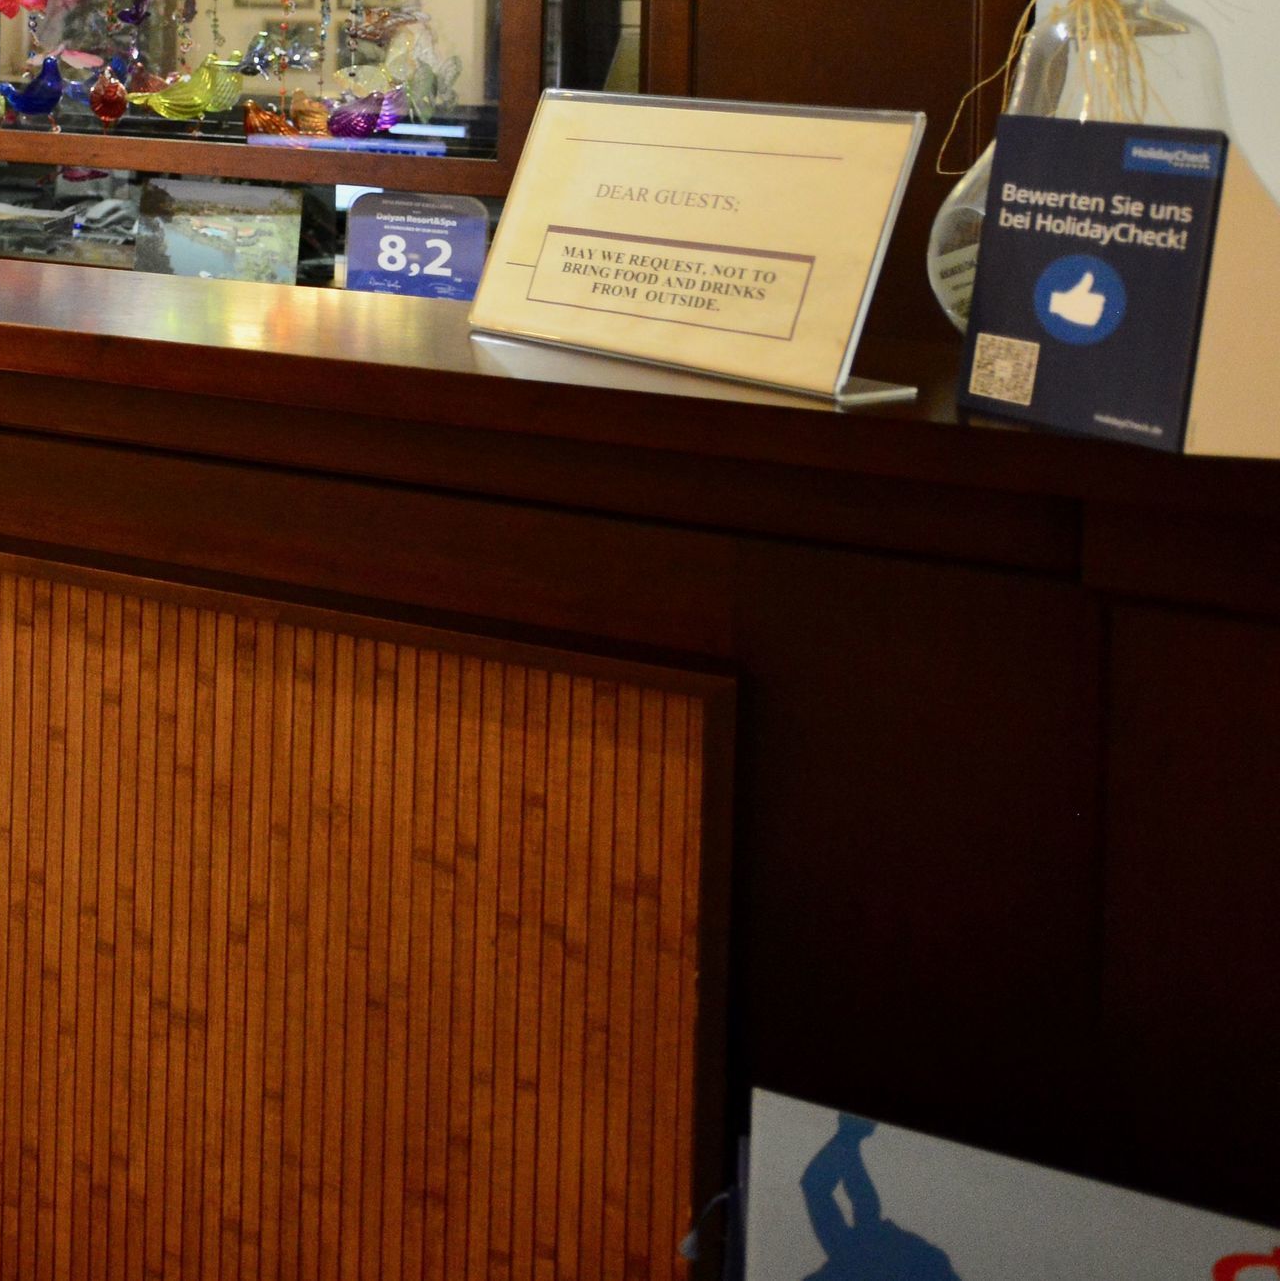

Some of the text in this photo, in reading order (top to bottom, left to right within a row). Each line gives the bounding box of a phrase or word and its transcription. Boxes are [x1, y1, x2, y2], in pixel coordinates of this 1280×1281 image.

[595, 183, 649, 203] DEAR
[1001, 183, 1193, 223] Bewerten Sie uns
[376, 212, 457, 227] Dalyan Resort&Spa
[998, 207, 1188, 250] bei HolidayCheck!
[377, 234, 452, 277] 8,2
[561, 245, 598, 261] MAY
[601, 249, 629, 264] WE
[711, 264, 747, 280] NOT
[751, 269, 777, 284] TO
[561, 262, 767, 301] BRING FOOD AND DRINKS
[591, 282, 721, 312] FROM OUTSIDE.
